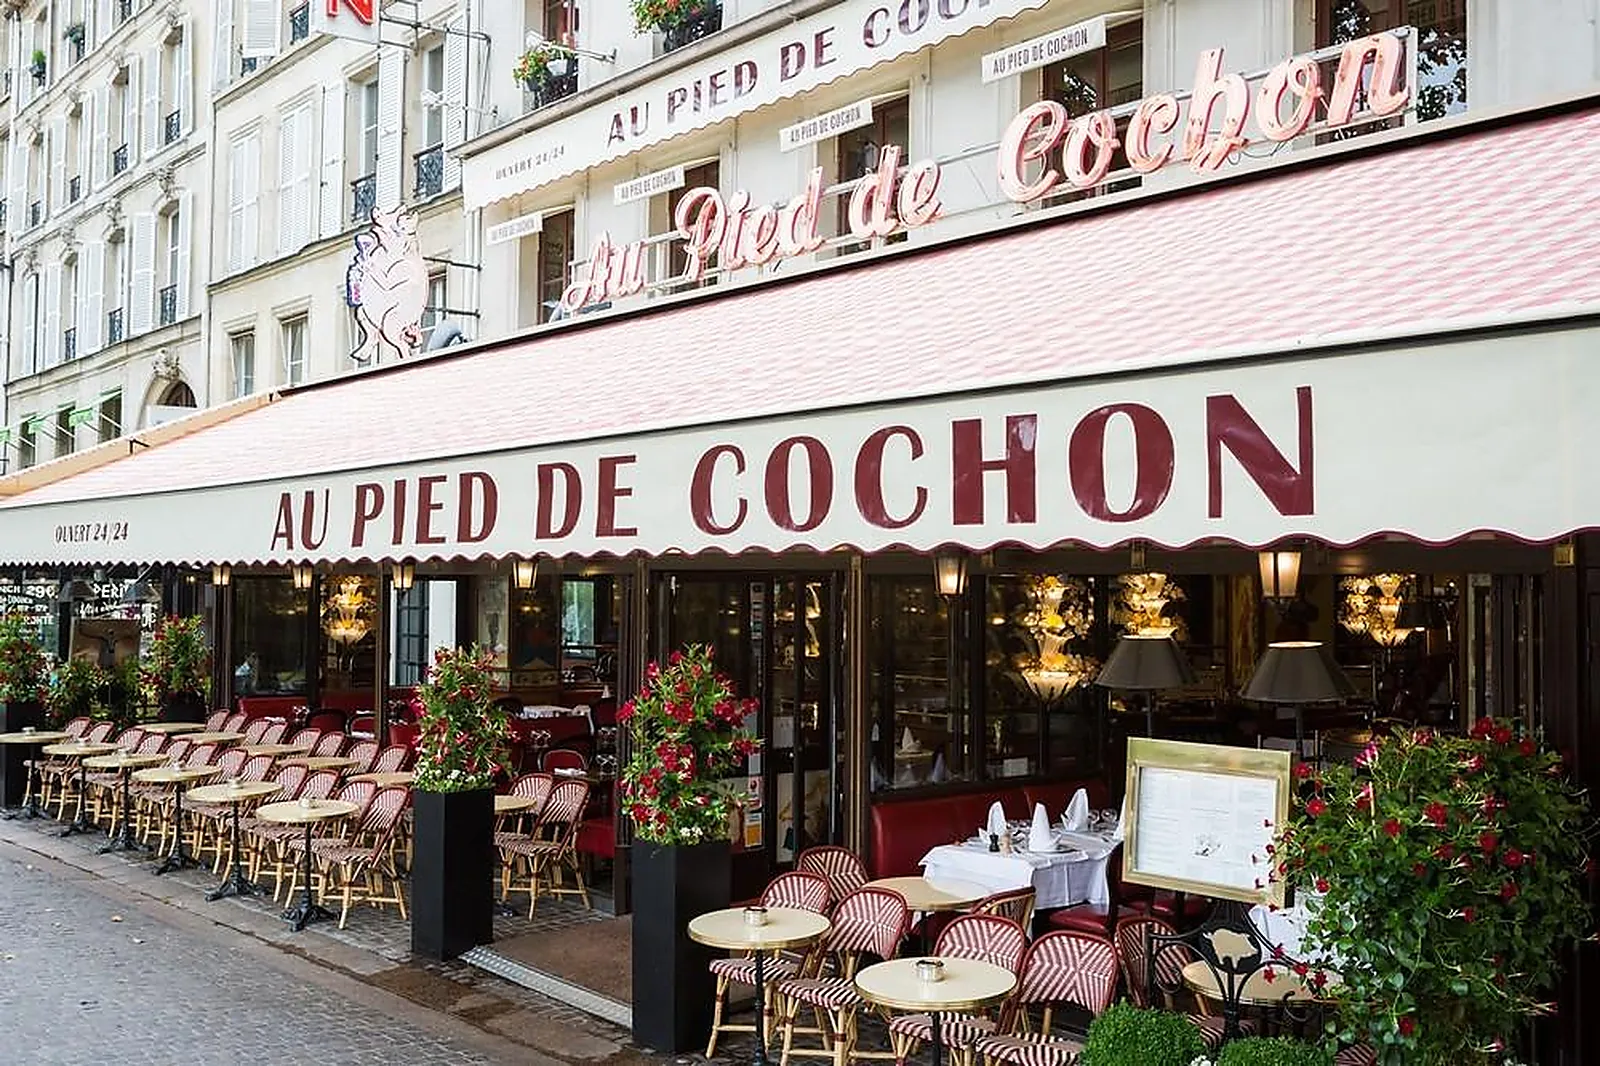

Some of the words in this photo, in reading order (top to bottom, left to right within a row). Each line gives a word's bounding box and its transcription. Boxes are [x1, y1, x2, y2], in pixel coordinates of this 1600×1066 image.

[606, 102, 649, 149] AU
[667, 60, 758, 123] PIED
[780, 26, 836, 82] DE
[993, 59, 1006, 75] AU
[1008, 49, 1030, 70] PIED
[1032, 43, 1044, 62] DE
[1047, 28, 1088, 57] COCHON
[999, 33, 1412, 203] Cochon
[559, 229, 648, 311] Au
[675, 165, 825, 282] Pied
[849, 144, 944, 238] de
[55, 524, 92, 543] OUVERT
[94, 522, 129, 545] 24/24
[270, 488, 330, 551] AU
[351, 471, 499, 547] PIED
[535, 454, 638, 541] DE
[690, 386, 1314, 536] COCHON
